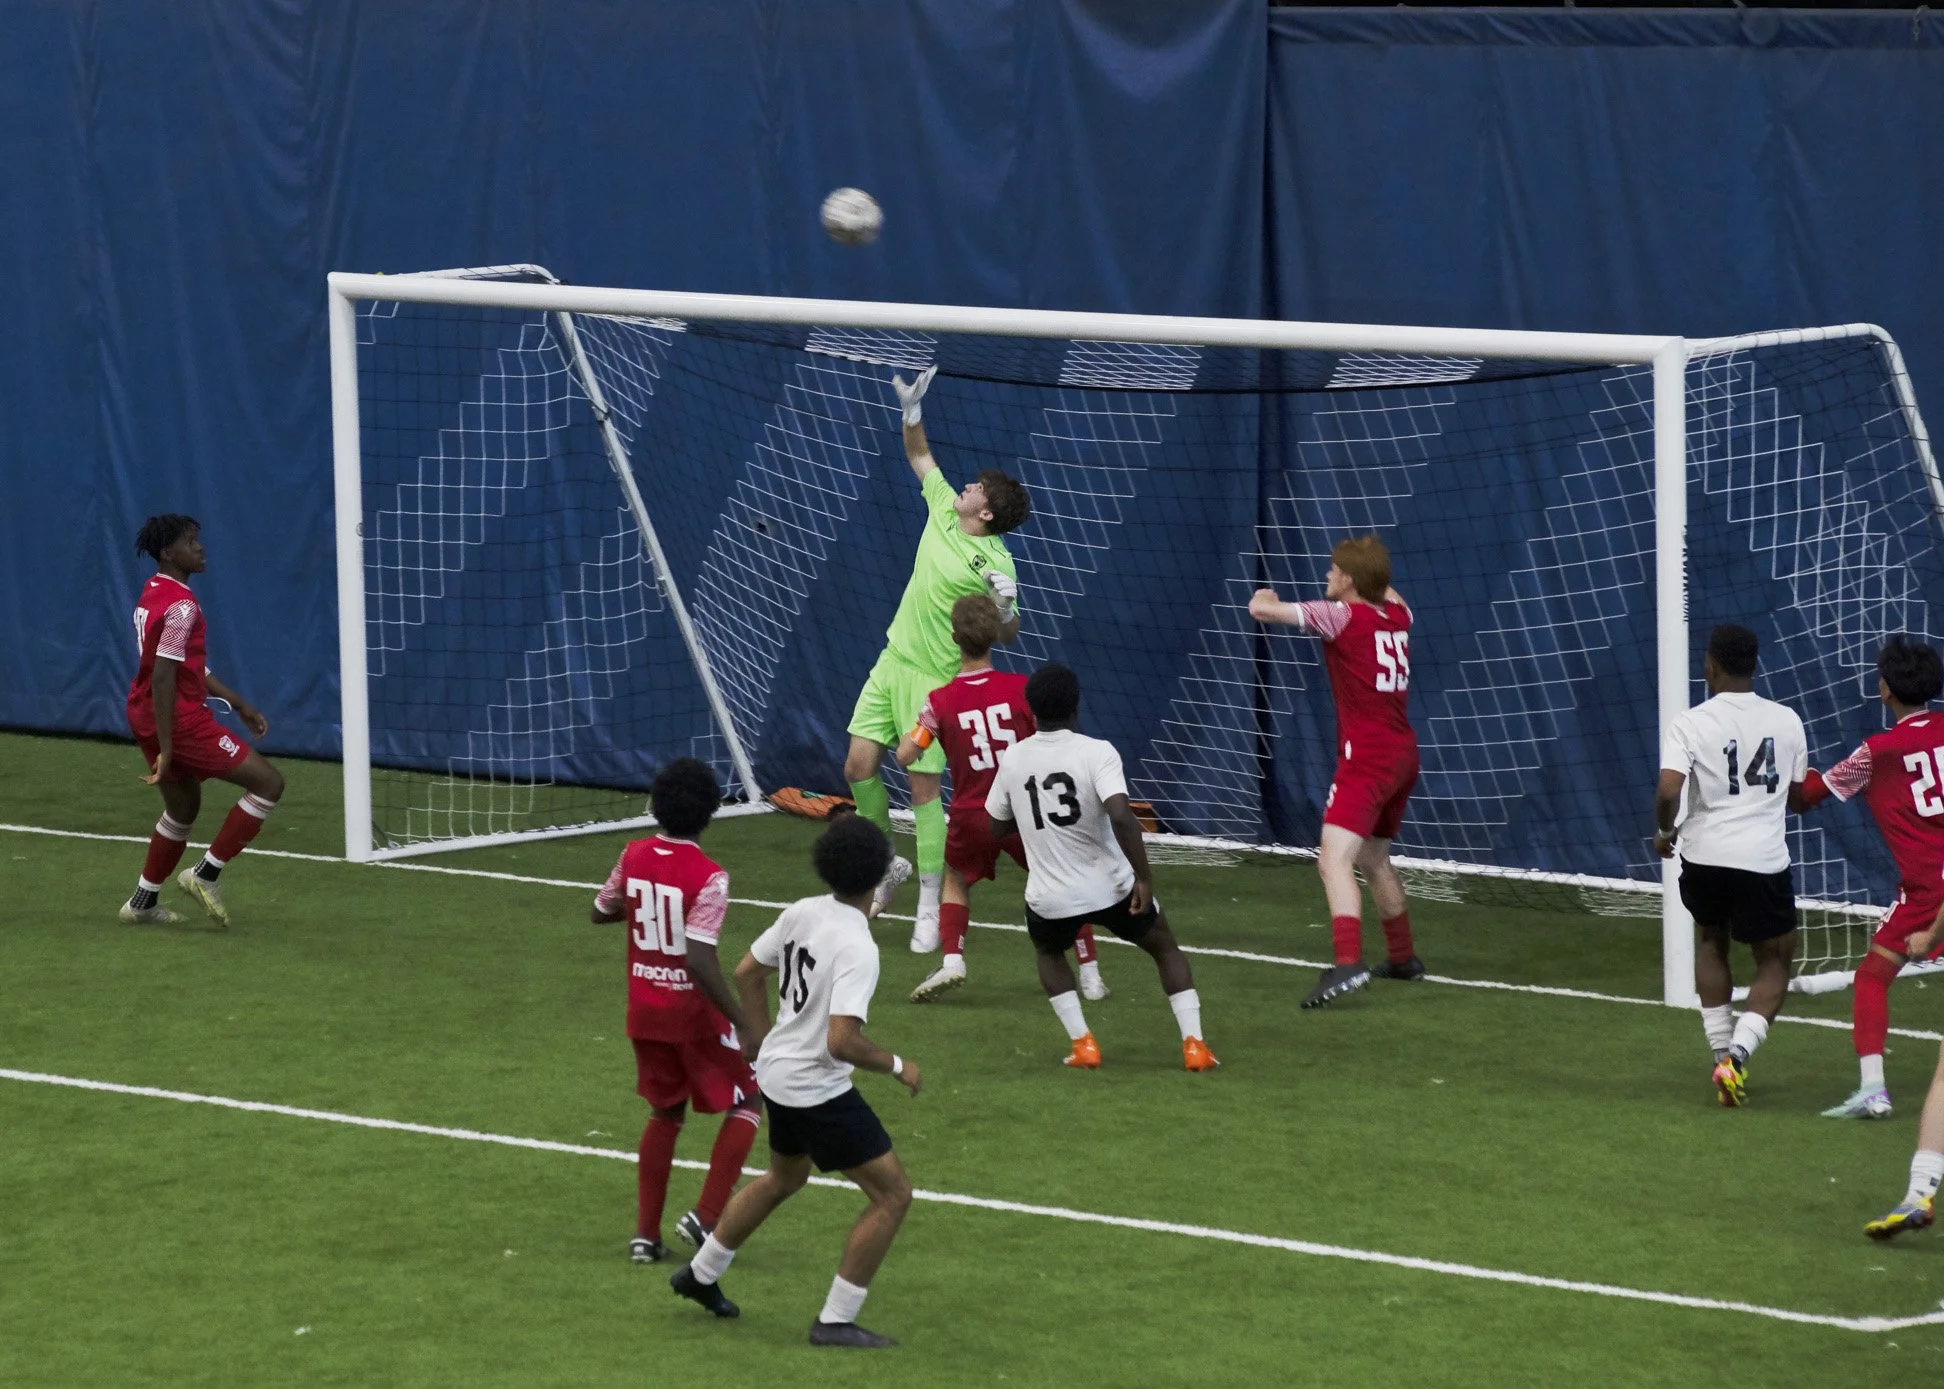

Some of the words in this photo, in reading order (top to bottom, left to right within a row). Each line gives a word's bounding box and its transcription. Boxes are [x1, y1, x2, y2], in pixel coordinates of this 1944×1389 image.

[1374, 630, 1410, 692] 55
[957, 702, 1017, 771] 35
[1723, 737, 1779, 795] 14
[1024, 771, 1081, 830] 13
[1903, 745, 1944, 817] 2
[627, 877, 687, 956] 30
[780, 939, 816, 1014] 15
